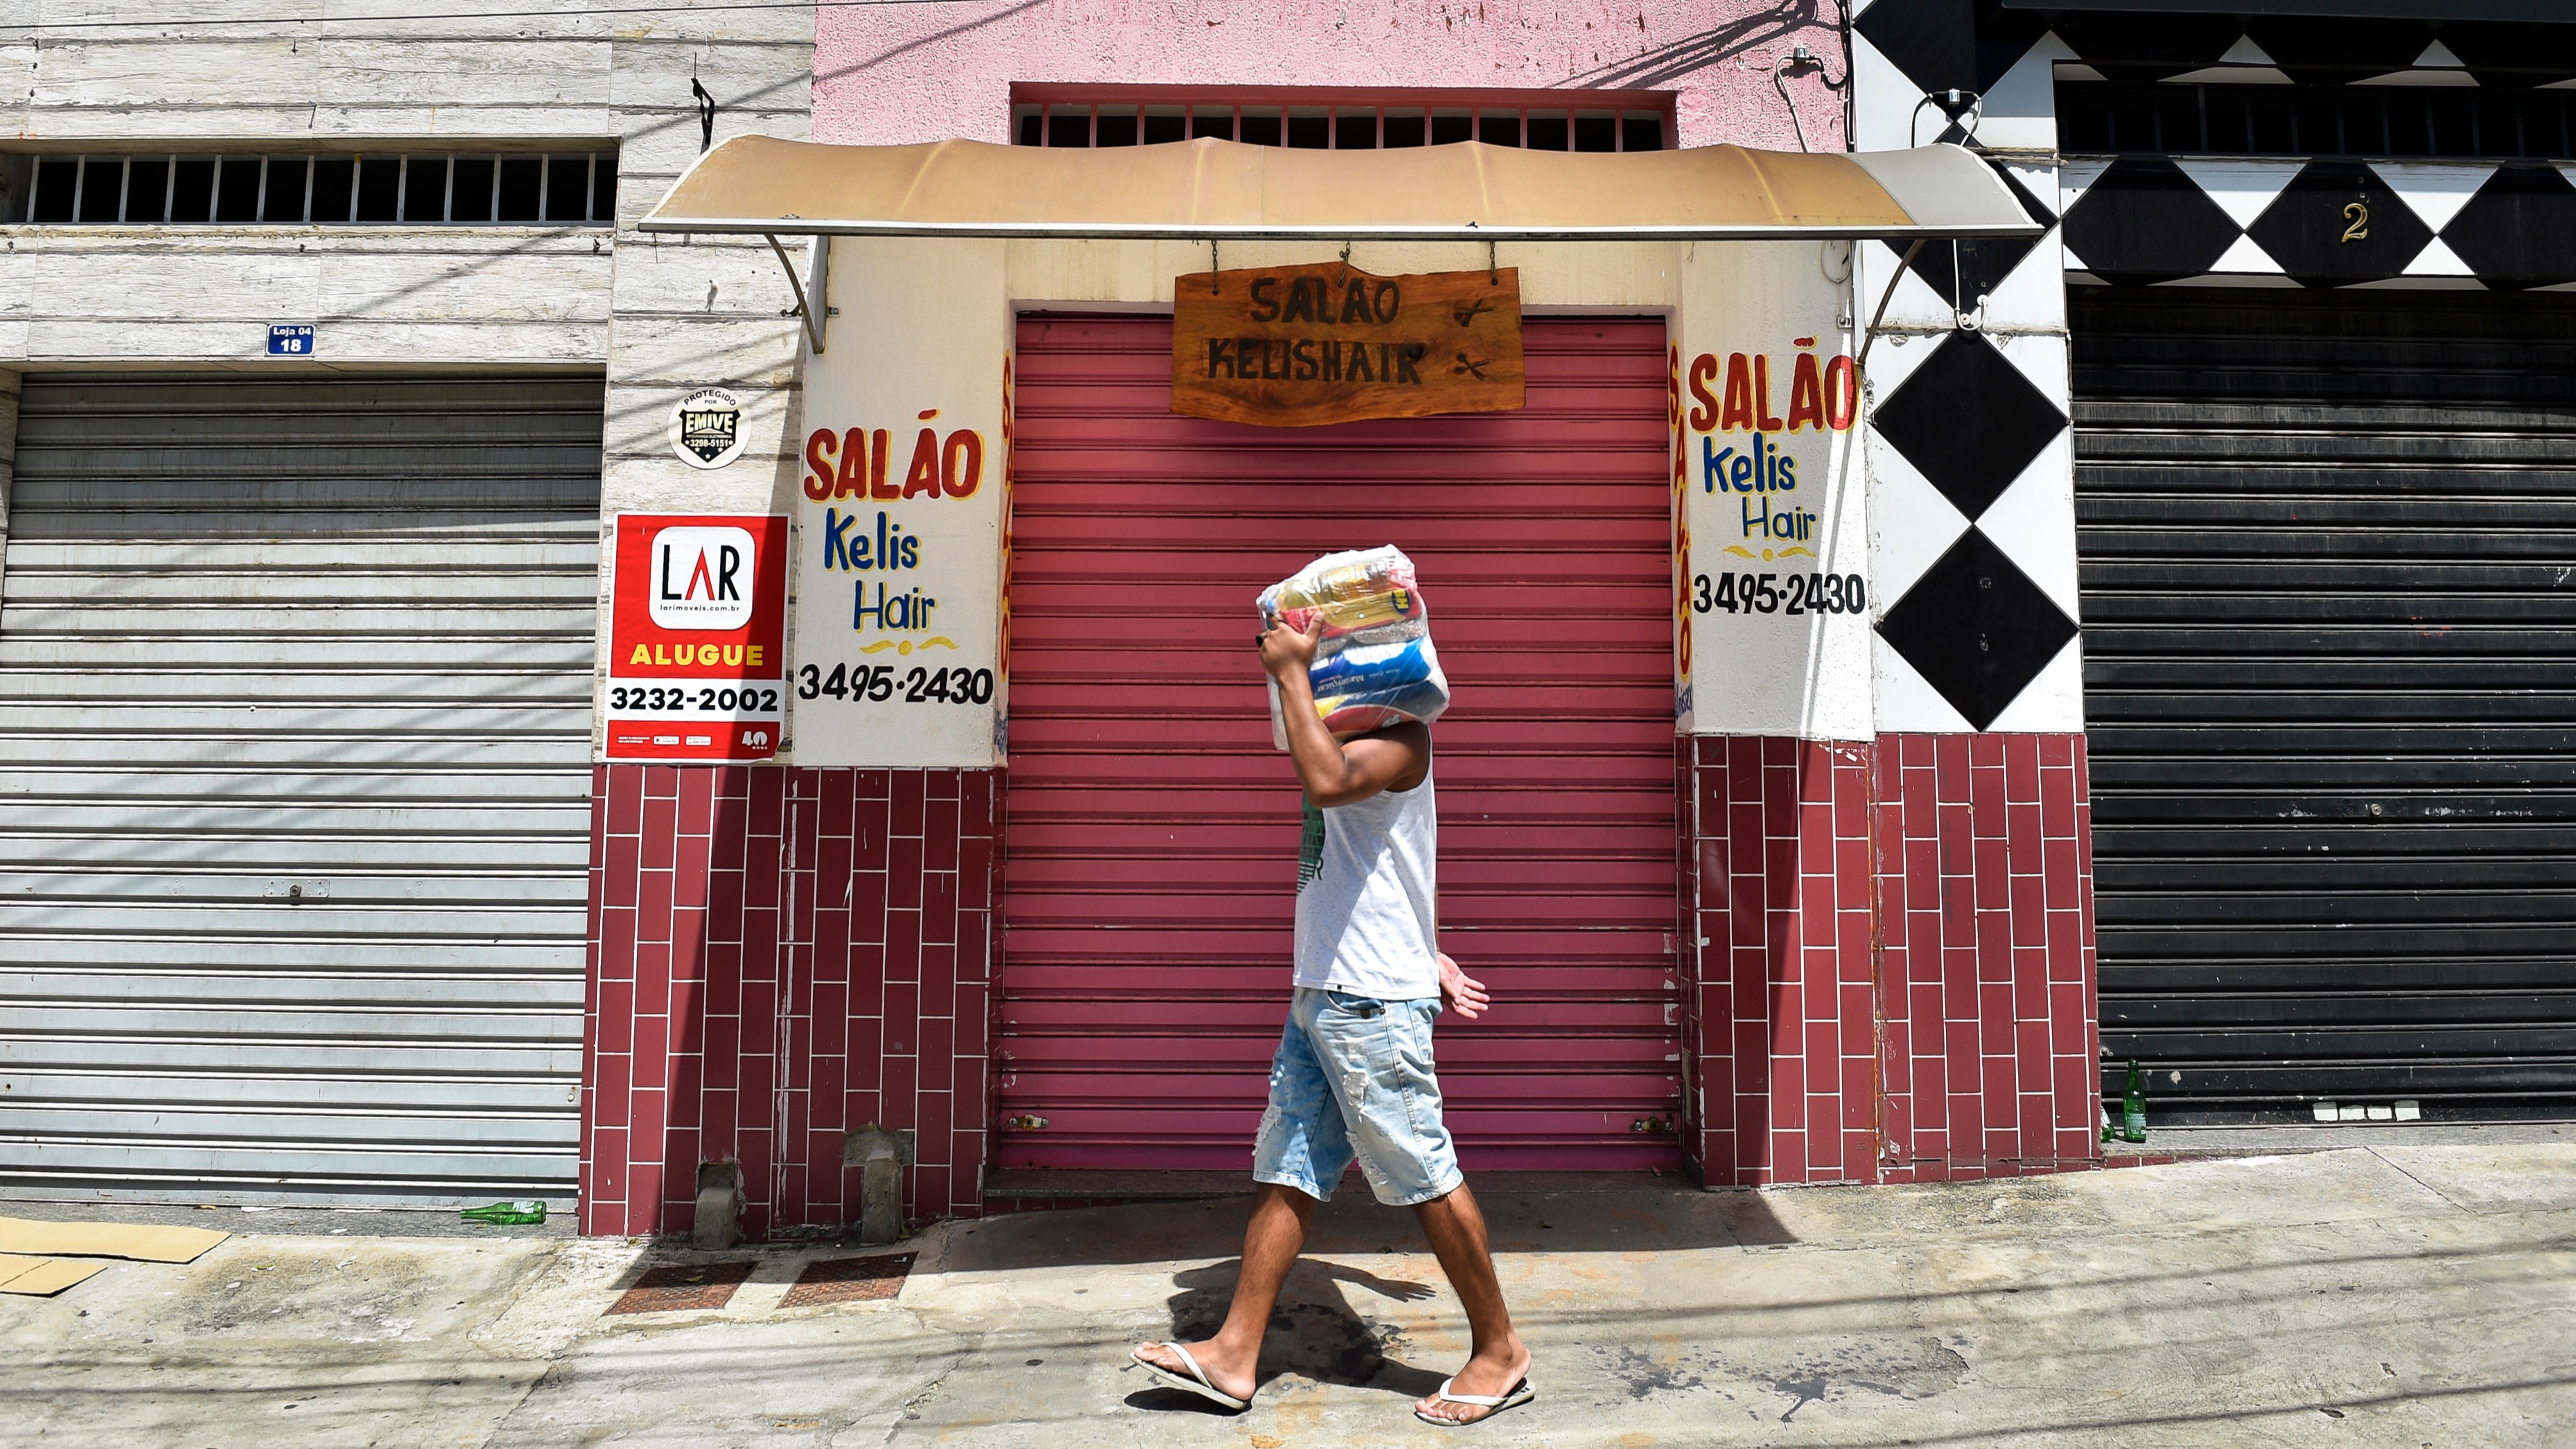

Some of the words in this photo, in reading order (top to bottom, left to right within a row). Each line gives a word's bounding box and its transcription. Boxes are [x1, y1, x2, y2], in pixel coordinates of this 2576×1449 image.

[2341, 203, 2368, 243] 2
[274, 327, 295, 337] Loja
[281, 339, 301, 352] 18
[1208, 337, 1424, 385] KELISHAIR
[684, 389, 736, 406] PROTEGIDO
[1689, 336, 1859, 433] SALÃO
[685, 414, 733, 434] EMIVE
[690, 439, 728, 447] 3298-5151
[1703, 432, 1798, 495] Kelis
[1742, 497, 1817, 541] Hair
[824, 507, 922, 573] Kelis
[661, 545, 740, 601] LAR
[853, 580, 938, 632] Hair
[630, 644, 763, 666] ALUGUE
[611, 687, 778, 712] 3232-2002
